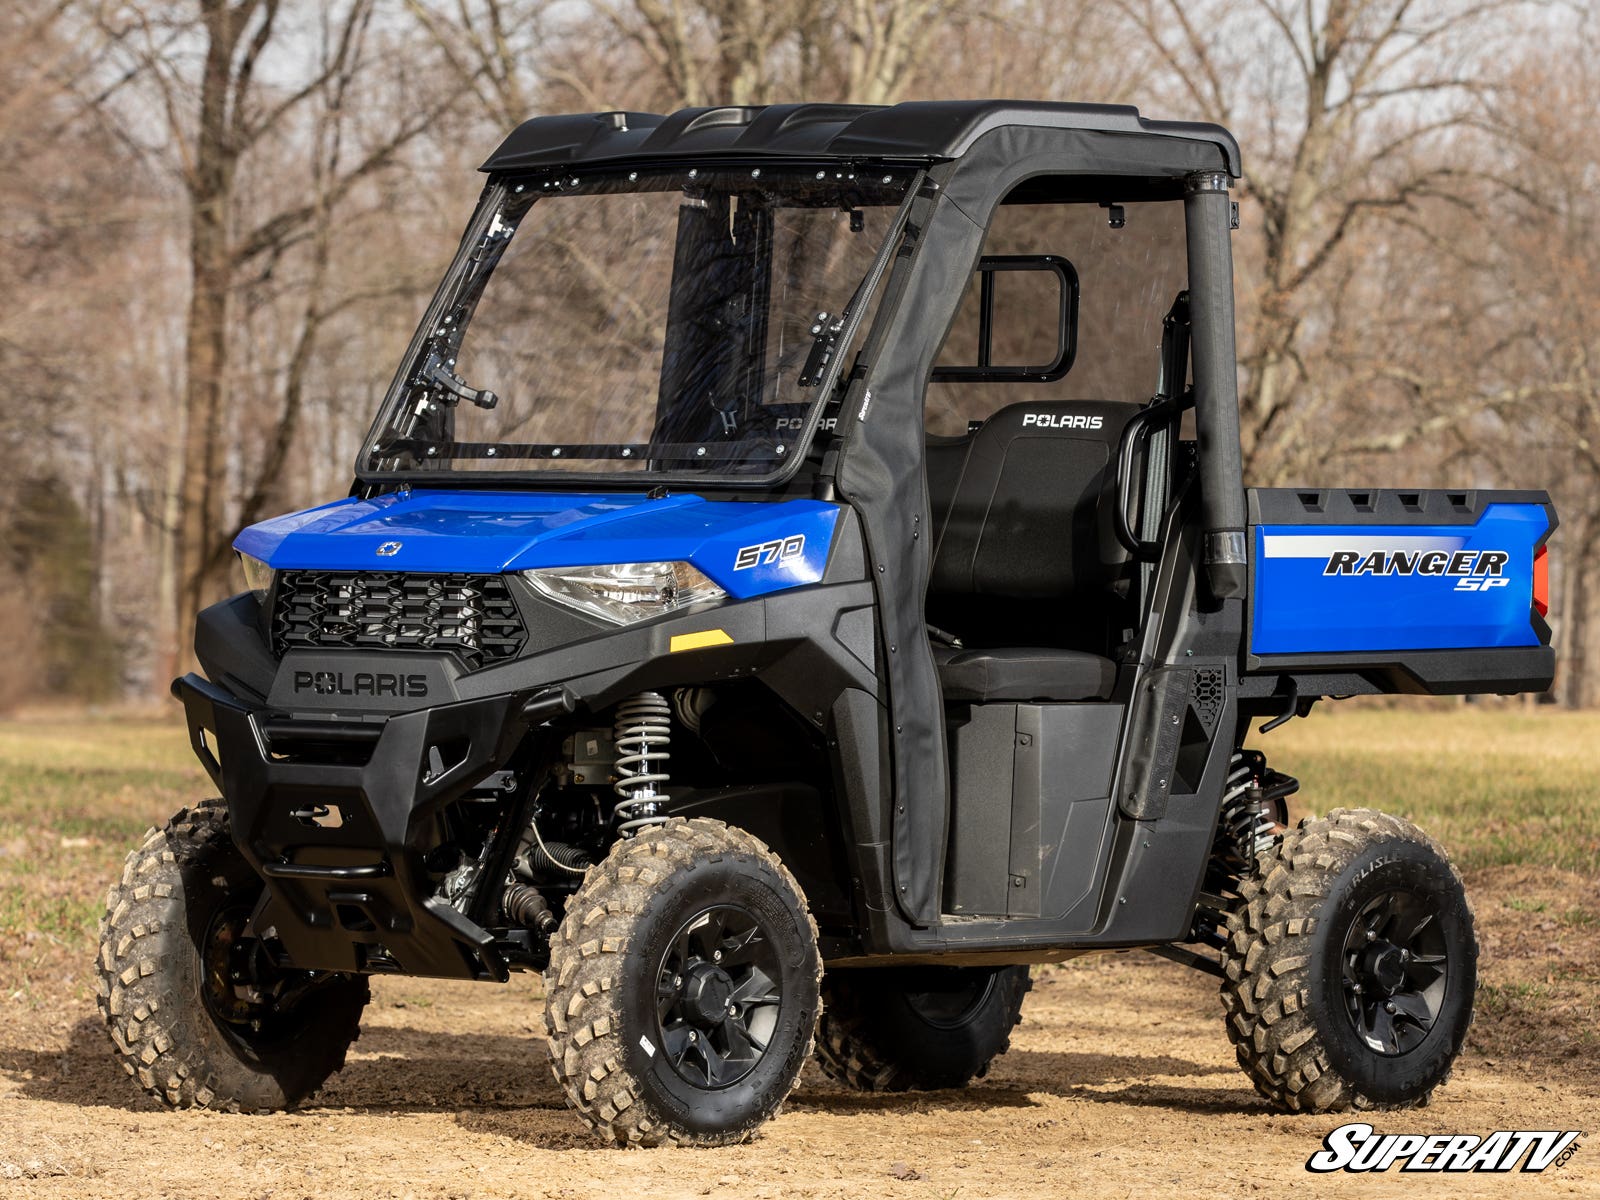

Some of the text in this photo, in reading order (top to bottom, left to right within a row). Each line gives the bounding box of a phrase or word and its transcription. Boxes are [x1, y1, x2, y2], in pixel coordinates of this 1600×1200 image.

[776, 418, 838, 430] POAR
[1022, 413, 1104, 430] POLARIS
[733, 533, 806, 571] 570
[1322, 550, 1509, 576] RANGER
[1453, 578, 1510, 591] SP
[294, 671, 428, 698] POLARIS
[1343, 848, 1402, 901] ARLISLE
